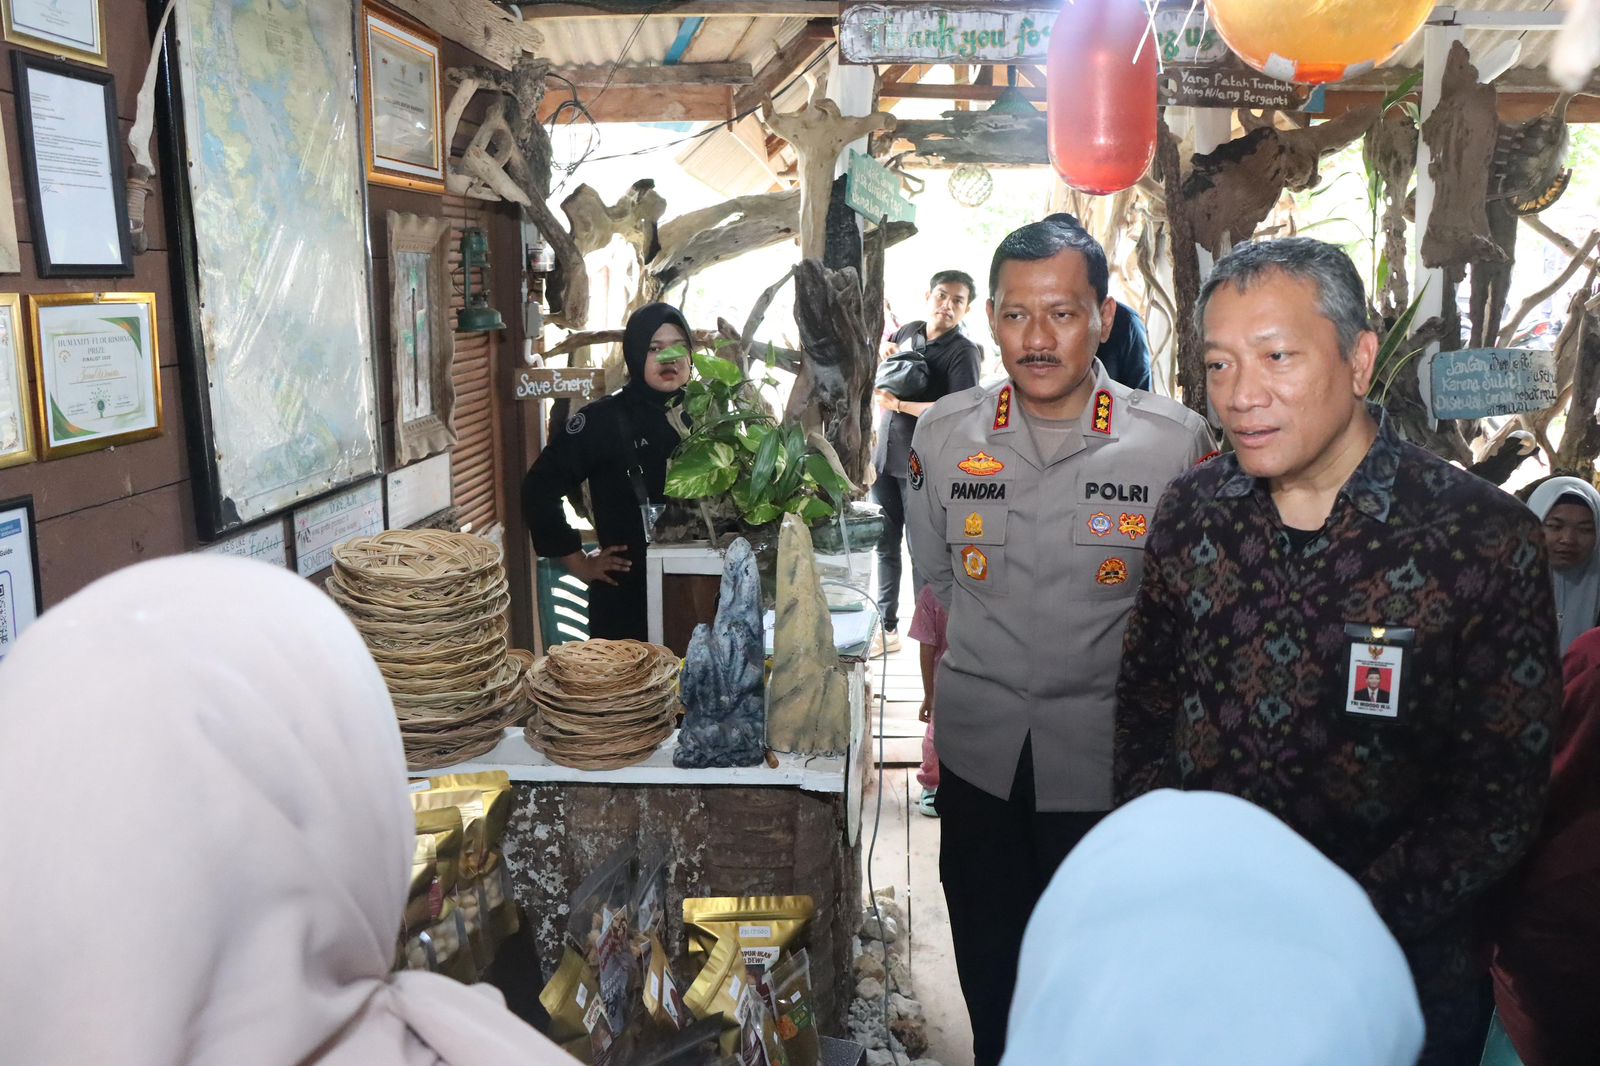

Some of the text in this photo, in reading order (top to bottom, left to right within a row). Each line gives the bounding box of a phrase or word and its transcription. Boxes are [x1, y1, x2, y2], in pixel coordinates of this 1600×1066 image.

[864, 15, 955, 53] Thank
[958, 27, 1007, 57] you
[1181, 71, 1209, 87] Yang
[1252, 77, 1293, 92] Tumbuh
[1182, 86, 1203, 98] Yang
[1244, 90, 1288, 106] Berganti
[517, 369, 595, 397] Save Energi
[950, 482, 1007, 500] PANDRA
[1085, 482, 1148, 503] POLRI
